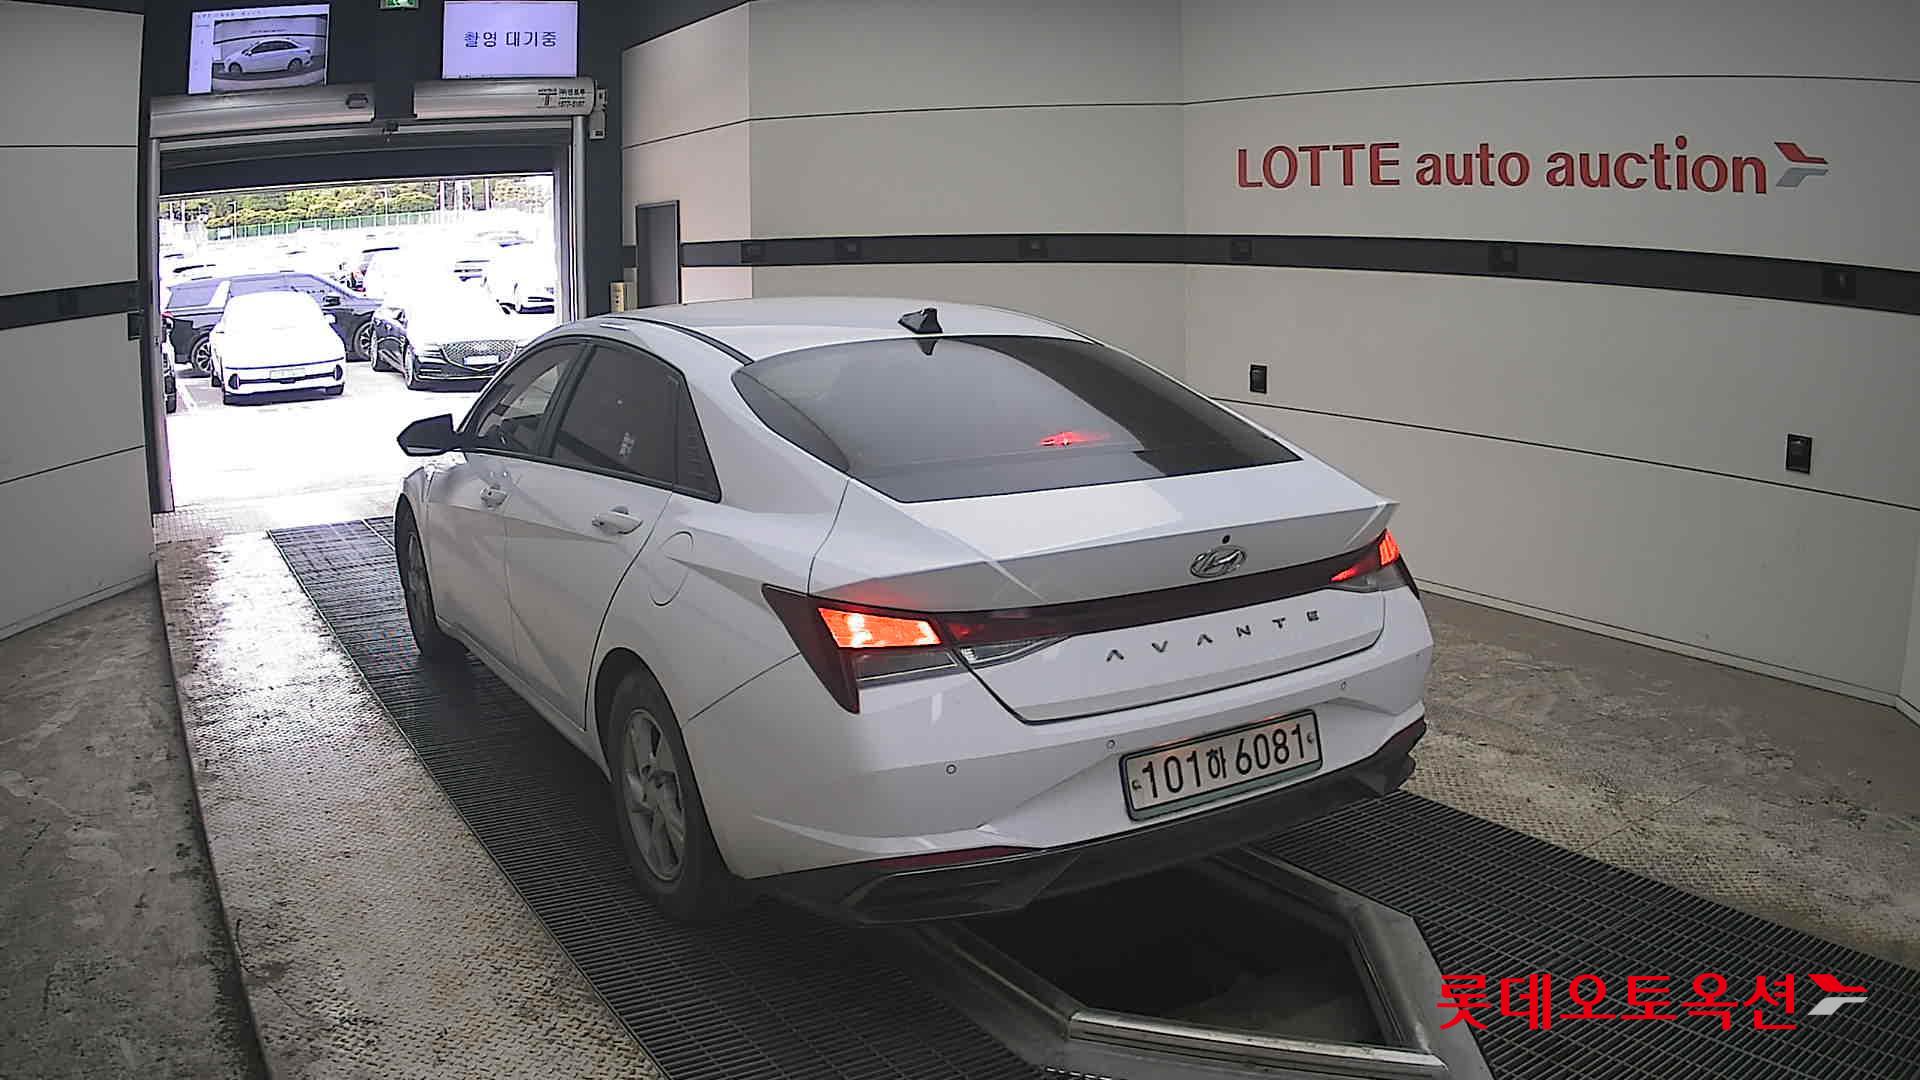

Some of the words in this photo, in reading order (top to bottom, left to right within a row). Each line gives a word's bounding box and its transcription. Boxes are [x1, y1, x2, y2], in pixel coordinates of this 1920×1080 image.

[505, 31, 557, 48] 대기중
[1238, 143, 1400, 189] LOTTE
[1416, 143, 1530, 188] auto
[1546, 135, 1768, 194] auction
[1105, 609, 1321, 662] AVANTE
